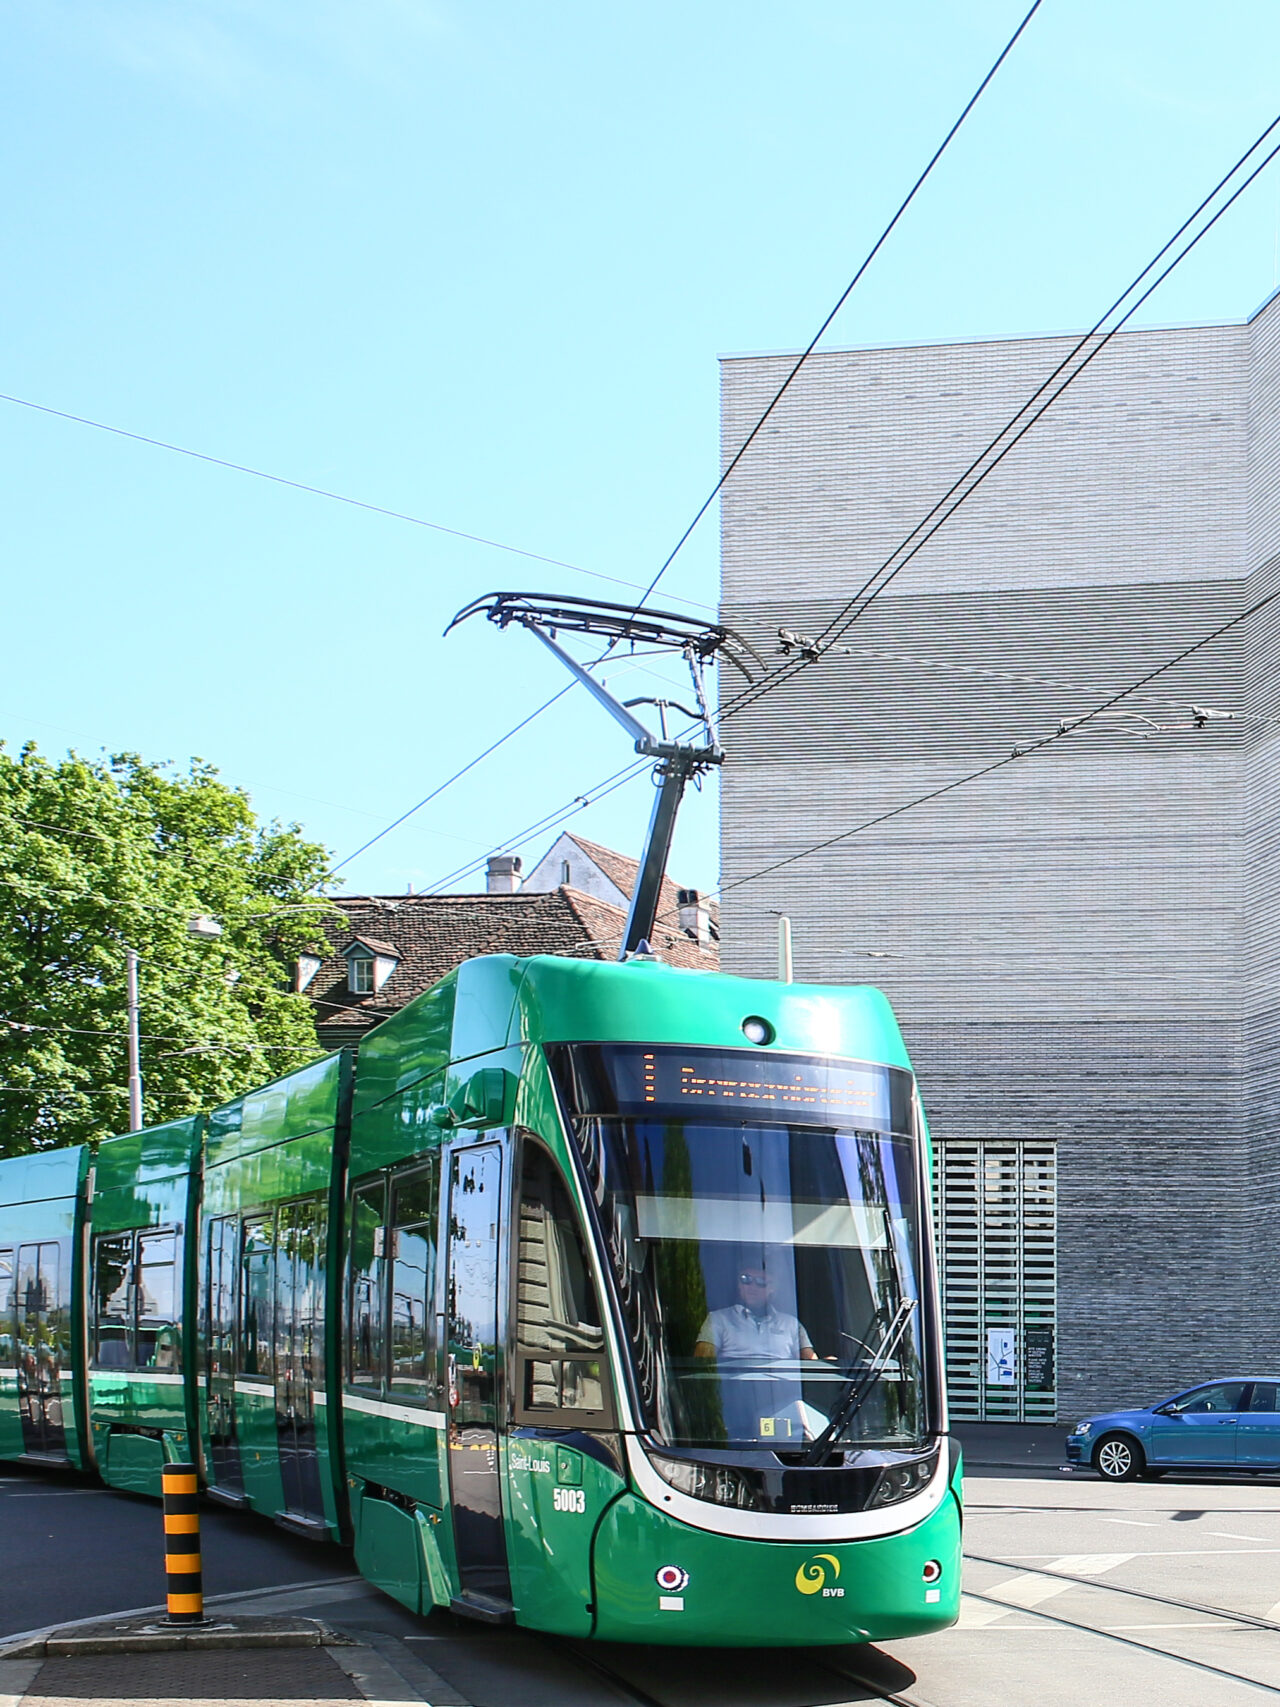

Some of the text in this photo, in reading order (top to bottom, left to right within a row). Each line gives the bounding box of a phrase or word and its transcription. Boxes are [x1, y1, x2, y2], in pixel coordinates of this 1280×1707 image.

[511, 1453, 550, 1473] Saint-Louis
[553, 1488, 586, 1514] 5003
[822, 1588, 845, 1598] BVB
